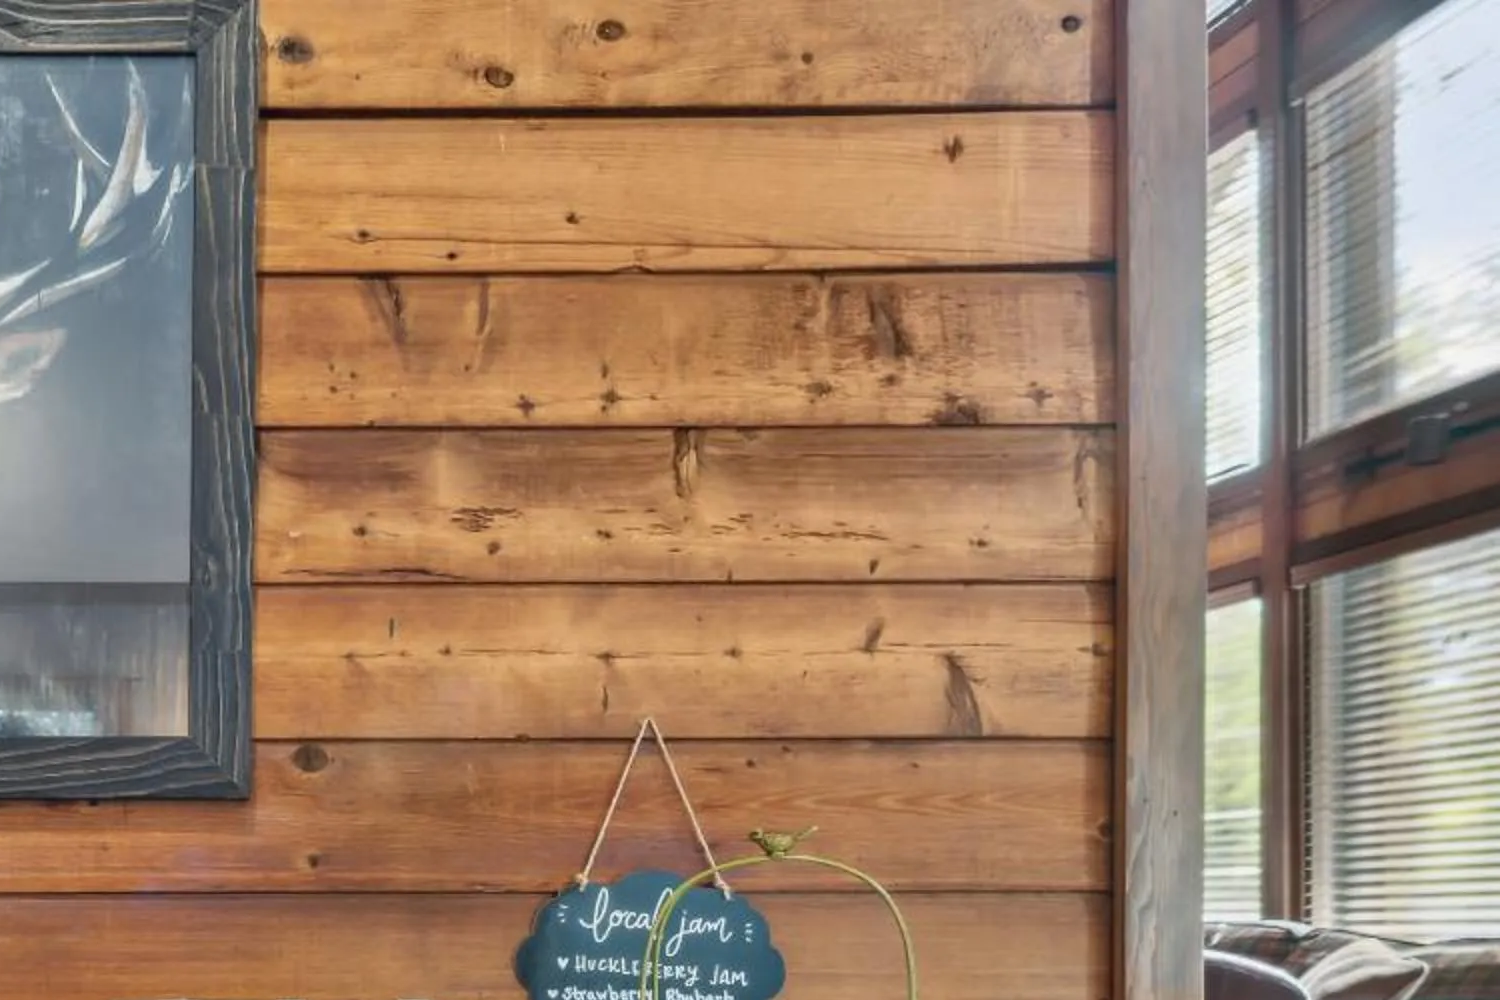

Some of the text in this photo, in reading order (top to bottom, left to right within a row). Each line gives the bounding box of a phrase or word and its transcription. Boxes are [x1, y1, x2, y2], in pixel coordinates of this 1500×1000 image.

[578, 887, 733, 957] local jam
[709, 963, 748, 986] JAM
